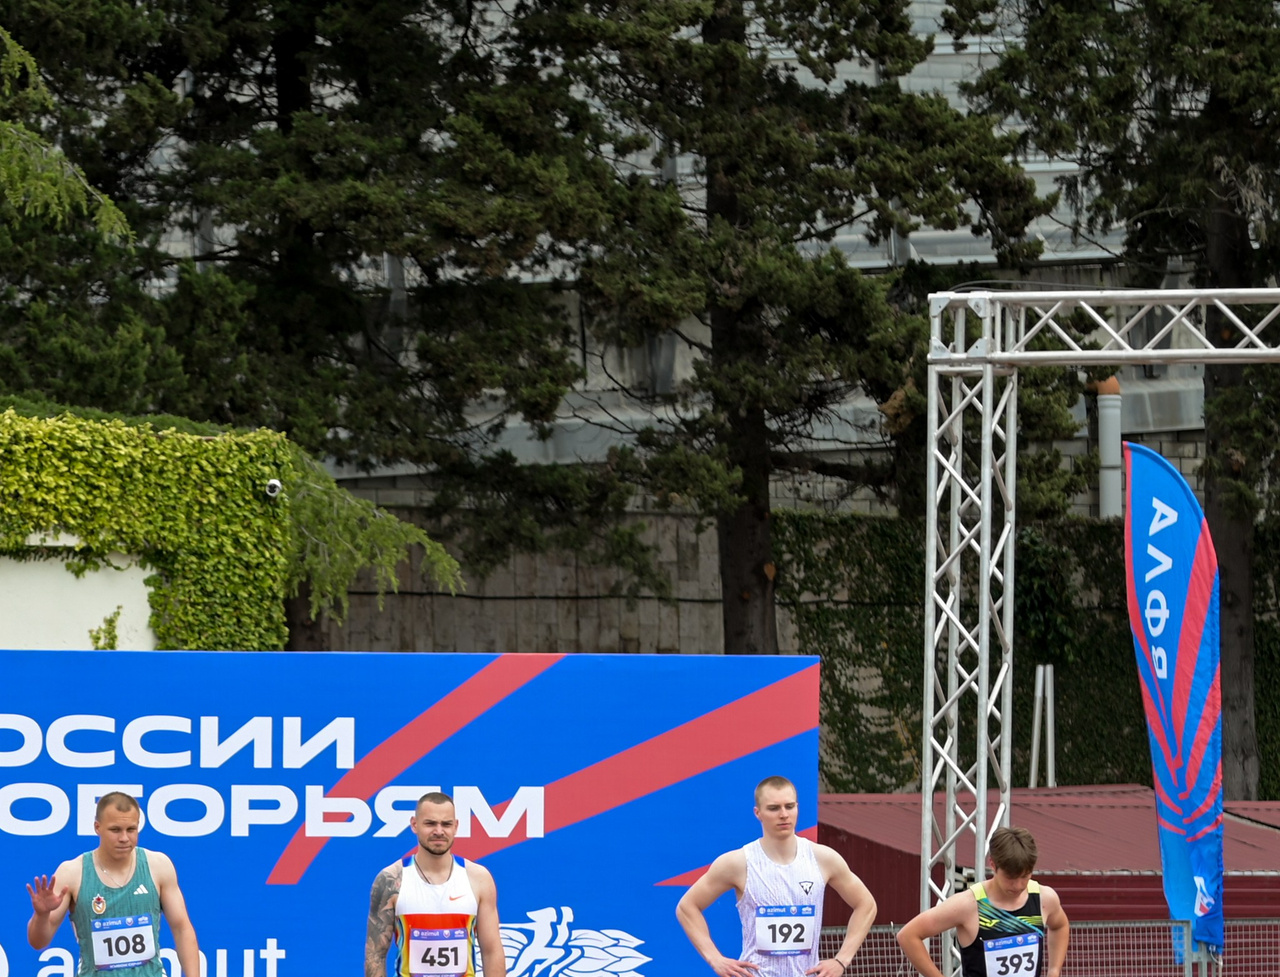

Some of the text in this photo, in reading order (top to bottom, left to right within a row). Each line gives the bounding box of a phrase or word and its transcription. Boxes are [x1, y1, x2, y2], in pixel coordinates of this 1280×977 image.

[768, 923, 805, 943] 192
[103, 934, 146, 957] 108
[421, 947, 458, 967] 451
[996, 952, 1035, 976] 393
